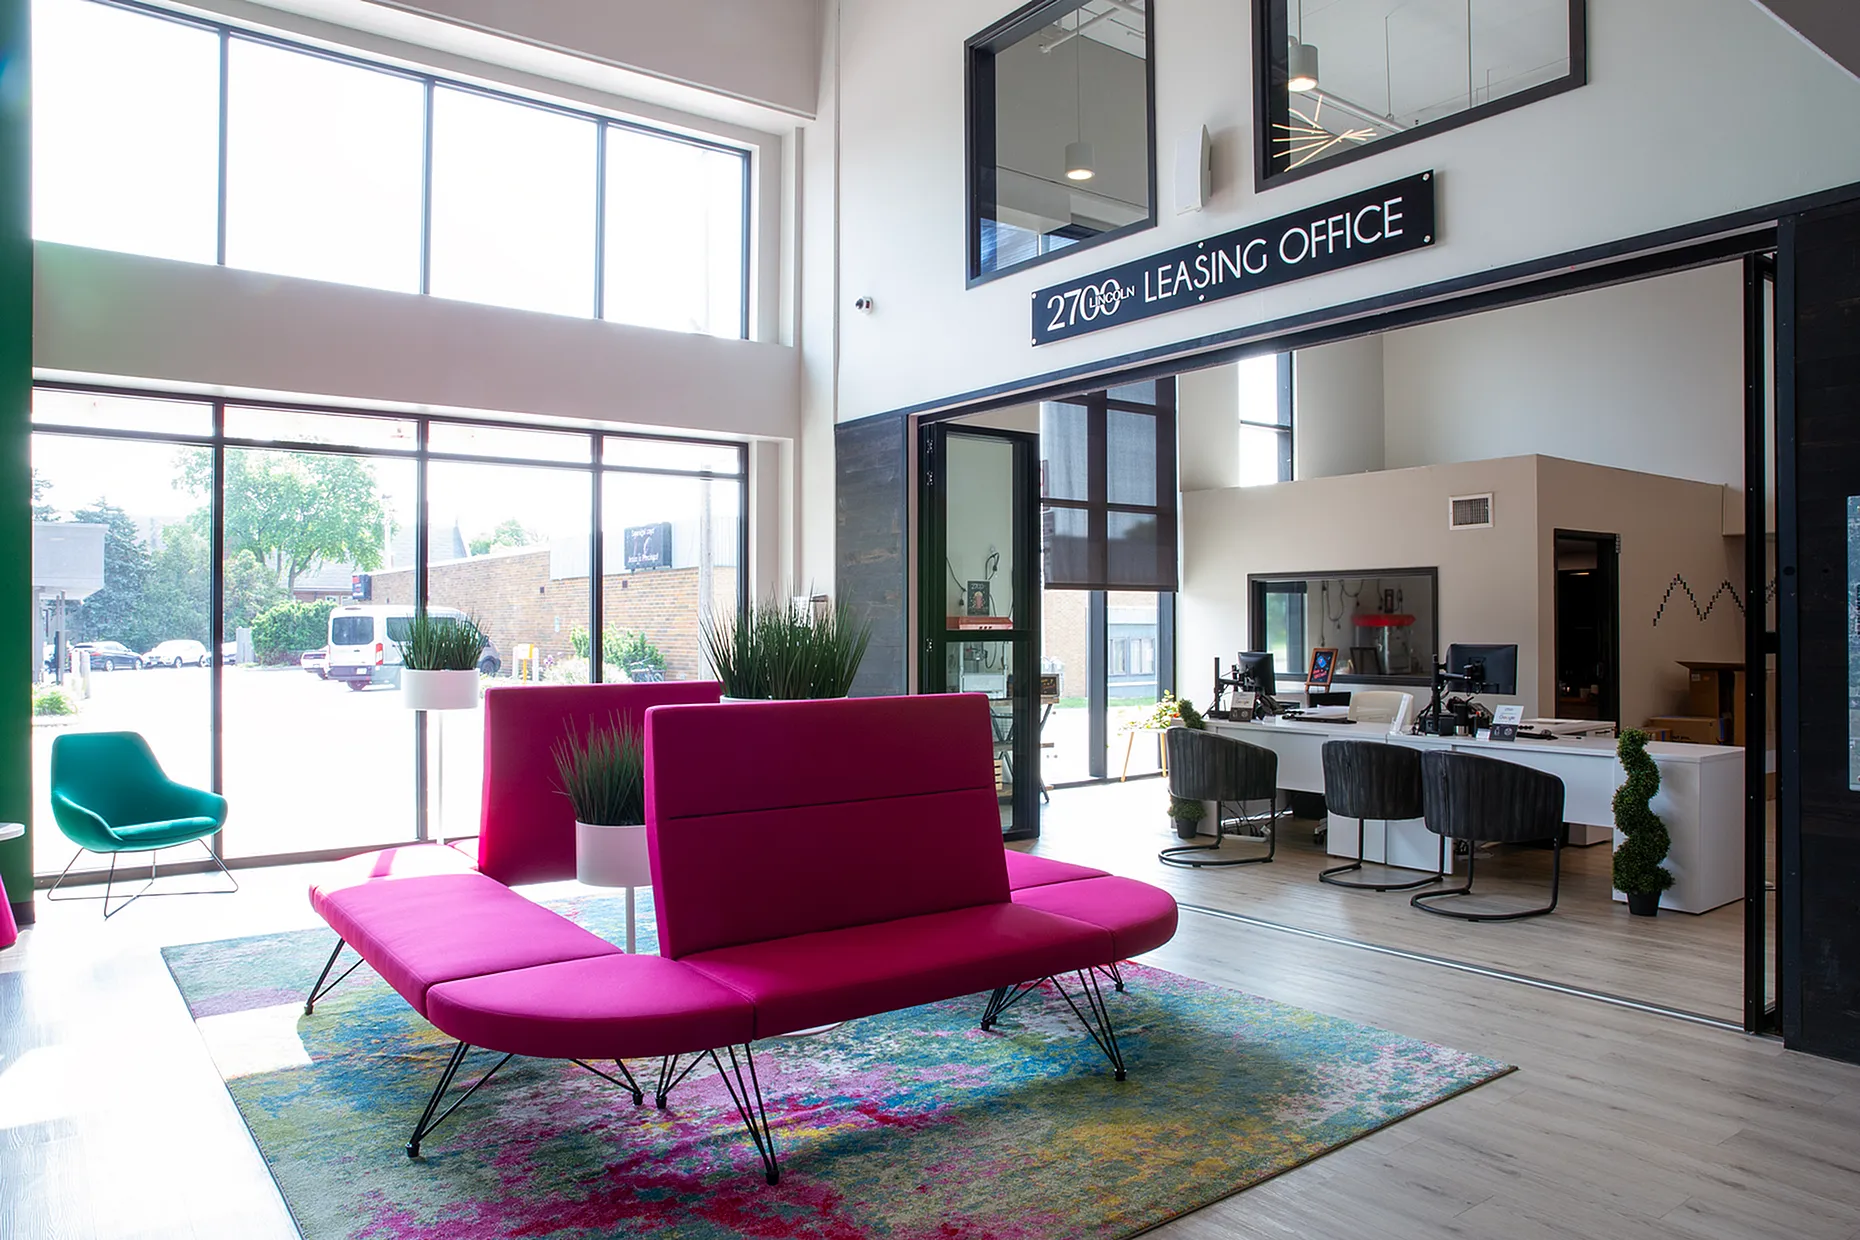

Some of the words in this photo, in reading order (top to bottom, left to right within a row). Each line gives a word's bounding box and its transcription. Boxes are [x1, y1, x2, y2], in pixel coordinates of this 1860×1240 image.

[1047, 279, 1121, 331] 2700
[1089, 286, 1135, 308] LINCOLN
[1144, 238, 1268, 303] LEASING
[1279, 197, 1403, 265] OFFICE
